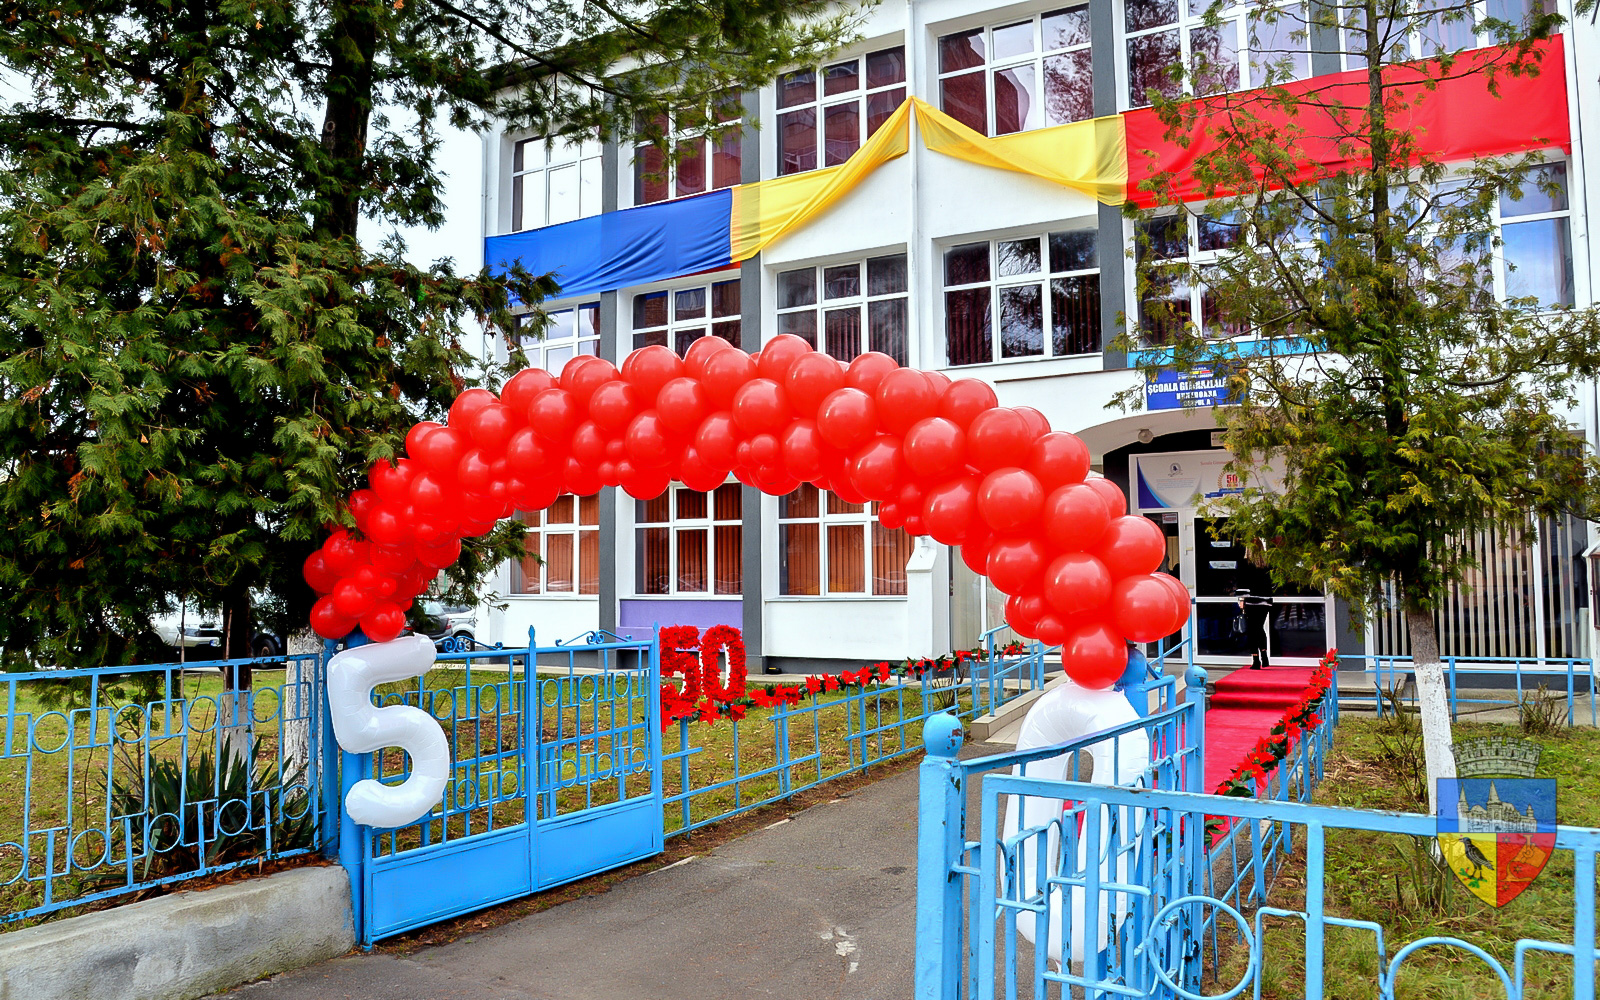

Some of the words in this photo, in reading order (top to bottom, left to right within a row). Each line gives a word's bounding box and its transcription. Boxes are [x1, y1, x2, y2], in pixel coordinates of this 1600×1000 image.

[1226, 474, 1239, 484] 50
[660, 624, 747, 704] 50
[326, 632, 450, 829] 5
